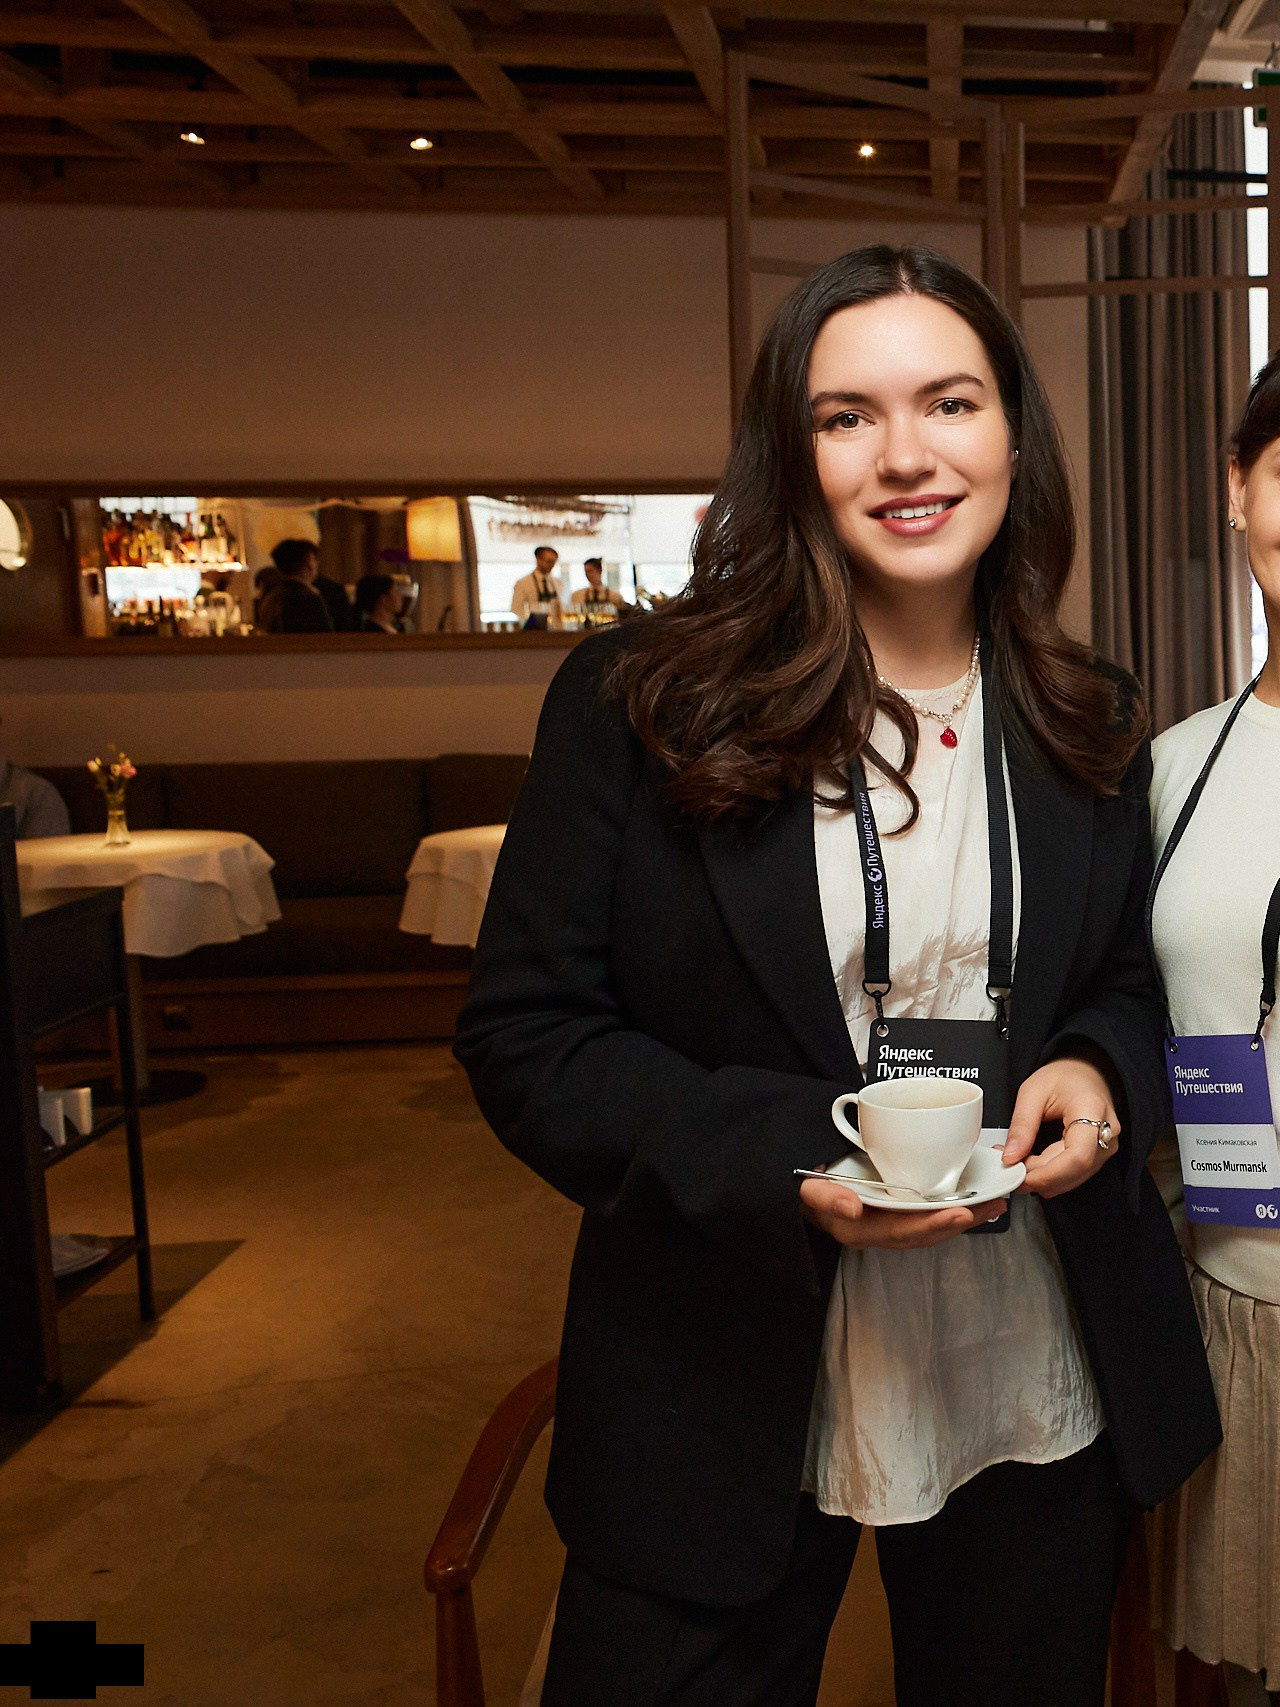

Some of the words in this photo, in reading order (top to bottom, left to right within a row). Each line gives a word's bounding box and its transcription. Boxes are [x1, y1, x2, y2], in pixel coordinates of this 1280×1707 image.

[859, 792, 880, 867] Путешествия
[872, 884, 885, 929] Яндекс
[879, 1044, 934, 1062] Яндекс
[876, 1062, 979, 1079] Путешествия
[1174, 1065, 1210, 1080] Яндекс
[1175, 1081, 1244, 1096] Путешествия
[1196, 1138, 1217, 1146] Ксения
[1190, 1159, 1222, 1172] Cosmos
[1222, 1160, 1267, 1173] Murmansk
[1191, 1204, 1220, 1213] Участник
